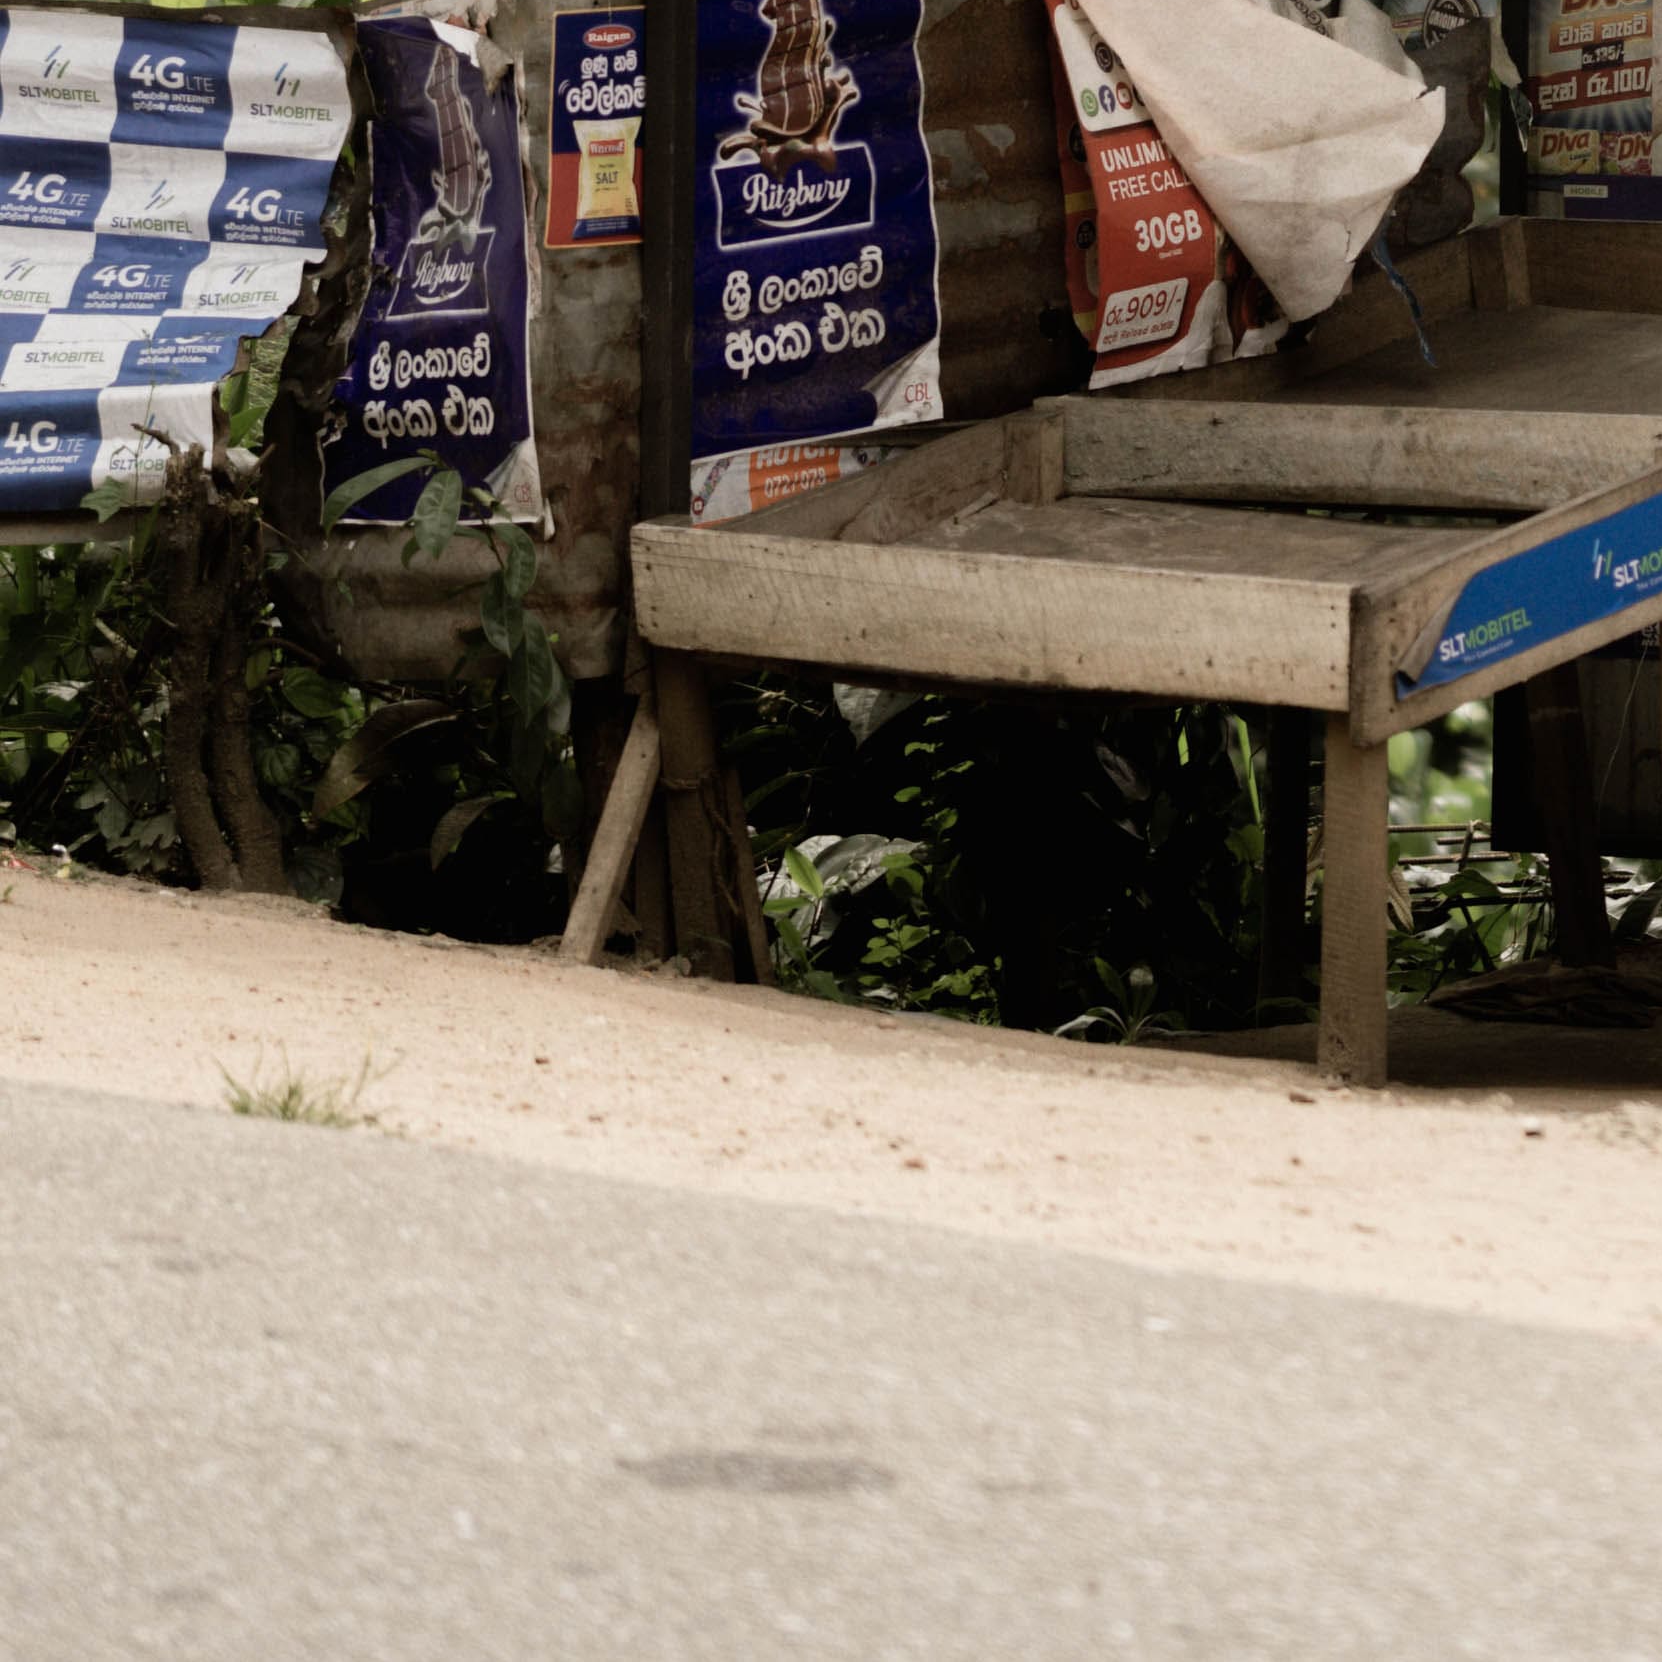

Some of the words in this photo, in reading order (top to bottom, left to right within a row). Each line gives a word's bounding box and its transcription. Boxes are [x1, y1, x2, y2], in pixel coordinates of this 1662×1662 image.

[588, 31, 632, 43] Raigam
[130, 54, 186, 89] 4G
[186, 75, 215, 93] LTE
[19, 85, 100, 103] SLTMOBITEL
[251, 103, 333, 122] SLTMOBITEL
[1100, 139, 1166, 173] UNLIMI
[1541, 131, 1589, 157] Diva
[1618, 135, 1651, 161] Div
[8, 172, 66, 203] 4G
[60, 192, 91, 207] LTE
[596, 170, 618, 185] SALT
[1108, 174, 1147, 202] FREE
[742, 168, 851, 218] Ritzbury
[226, 187, 281, 222] 4G
[277, 209, 304, 226] LTE
[111, 216, 192, 234] SLTMOBITEL
[1135, 208, 1202, 252] 30GB
[92, 264, 152, 288] 4G
[144, 274, 173, 288] LTE
[0, 290, 51, 304] OBITEL
[199, 291, 280, 307] SLTMOBITEL
[24, 351, 104, 364] SLTMOBITEL
[904, 381, 933, 404] CBL
[5, 421, 56, 454] 4G
[57, 438, 86, 453] LTE
[111, 459, 164, 472] SLTMOB
[1439, 607, 1532, 663] SLTMOBITEL
